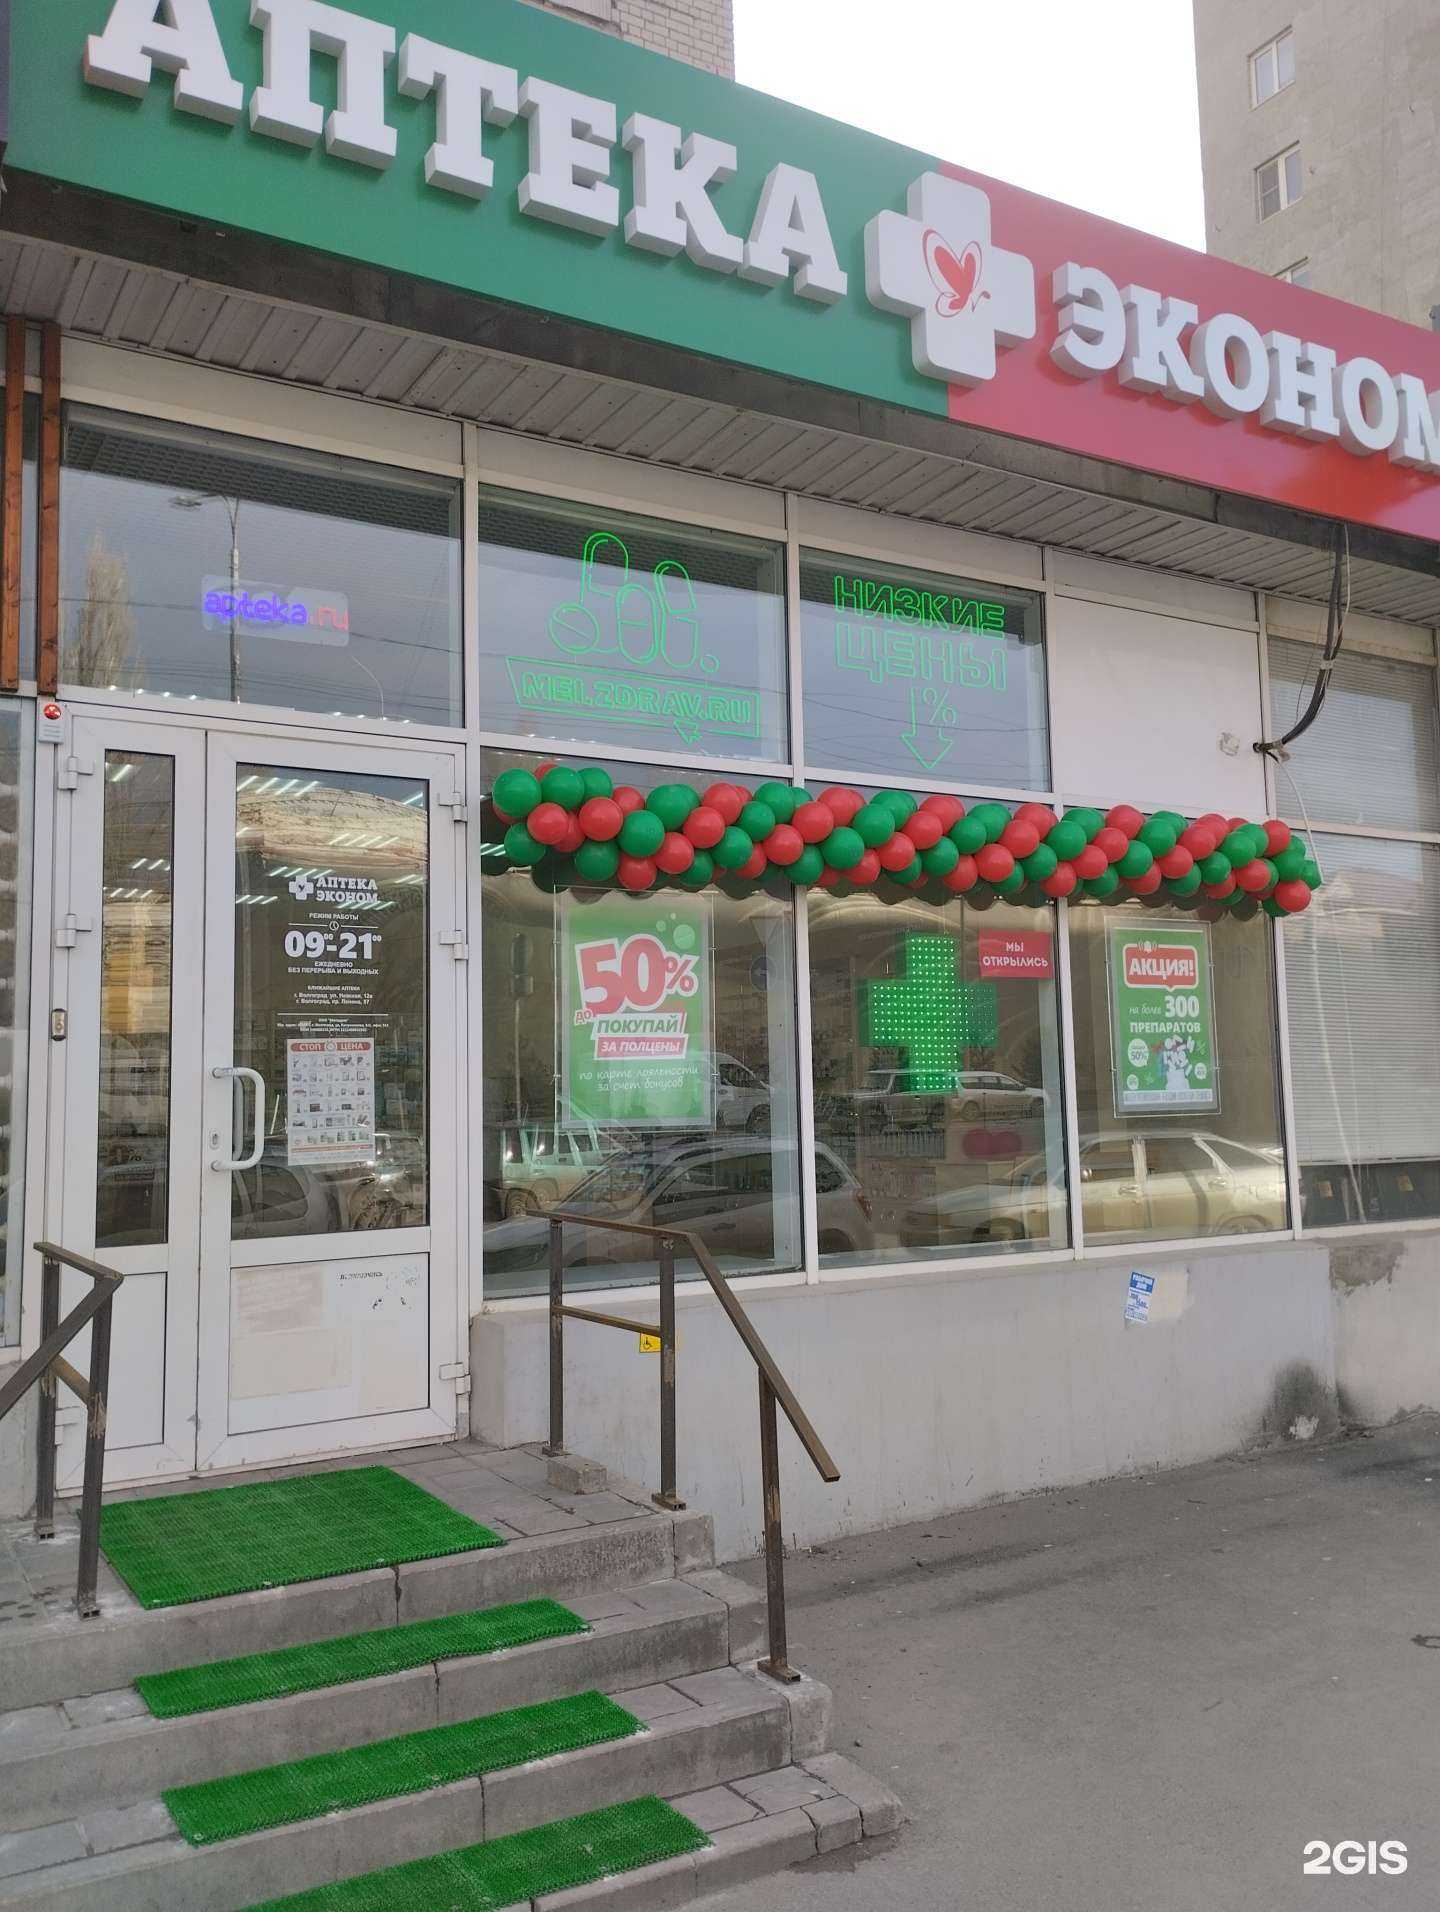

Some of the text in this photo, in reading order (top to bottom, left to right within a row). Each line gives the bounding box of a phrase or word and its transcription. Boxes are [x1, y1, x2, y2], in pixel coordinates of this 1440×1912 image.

[83, 0, 848, 305] АПТЕКА
[834, 575, 1005, 640] НИЗКИЕ
[834, 621, 1008, 691] ЦЕНЫ
[520, 671, 752, 724] MELZDRAV.RU
[316, 876, 378, 890] АПТЕКА
[315, 890, 378, 904] ЭКОНОМ
[309, 912, 359, 921] РЕЖИМ РАБОТЫ
[1005, 941, 1024, 952] МЫ
[982, 956, 1049, 968] ОТКРЫЛИСЬ
[1129, 957, 1195, 980] АКЦИЯ!
[577, 935, 698, 1014] 50%
[1164, 995, 1200, 1018] 300
[597, 1013, 678, 1034] ПОКУПАЙ
[1129, 1022, 1201, 1033] ПРЕПАРАТОВ
[299, 1042, 364, 1051] СТОП ЦЕНА
[600, 1041, 681, 1055] ЗА ПОЛЦЕНЫ
